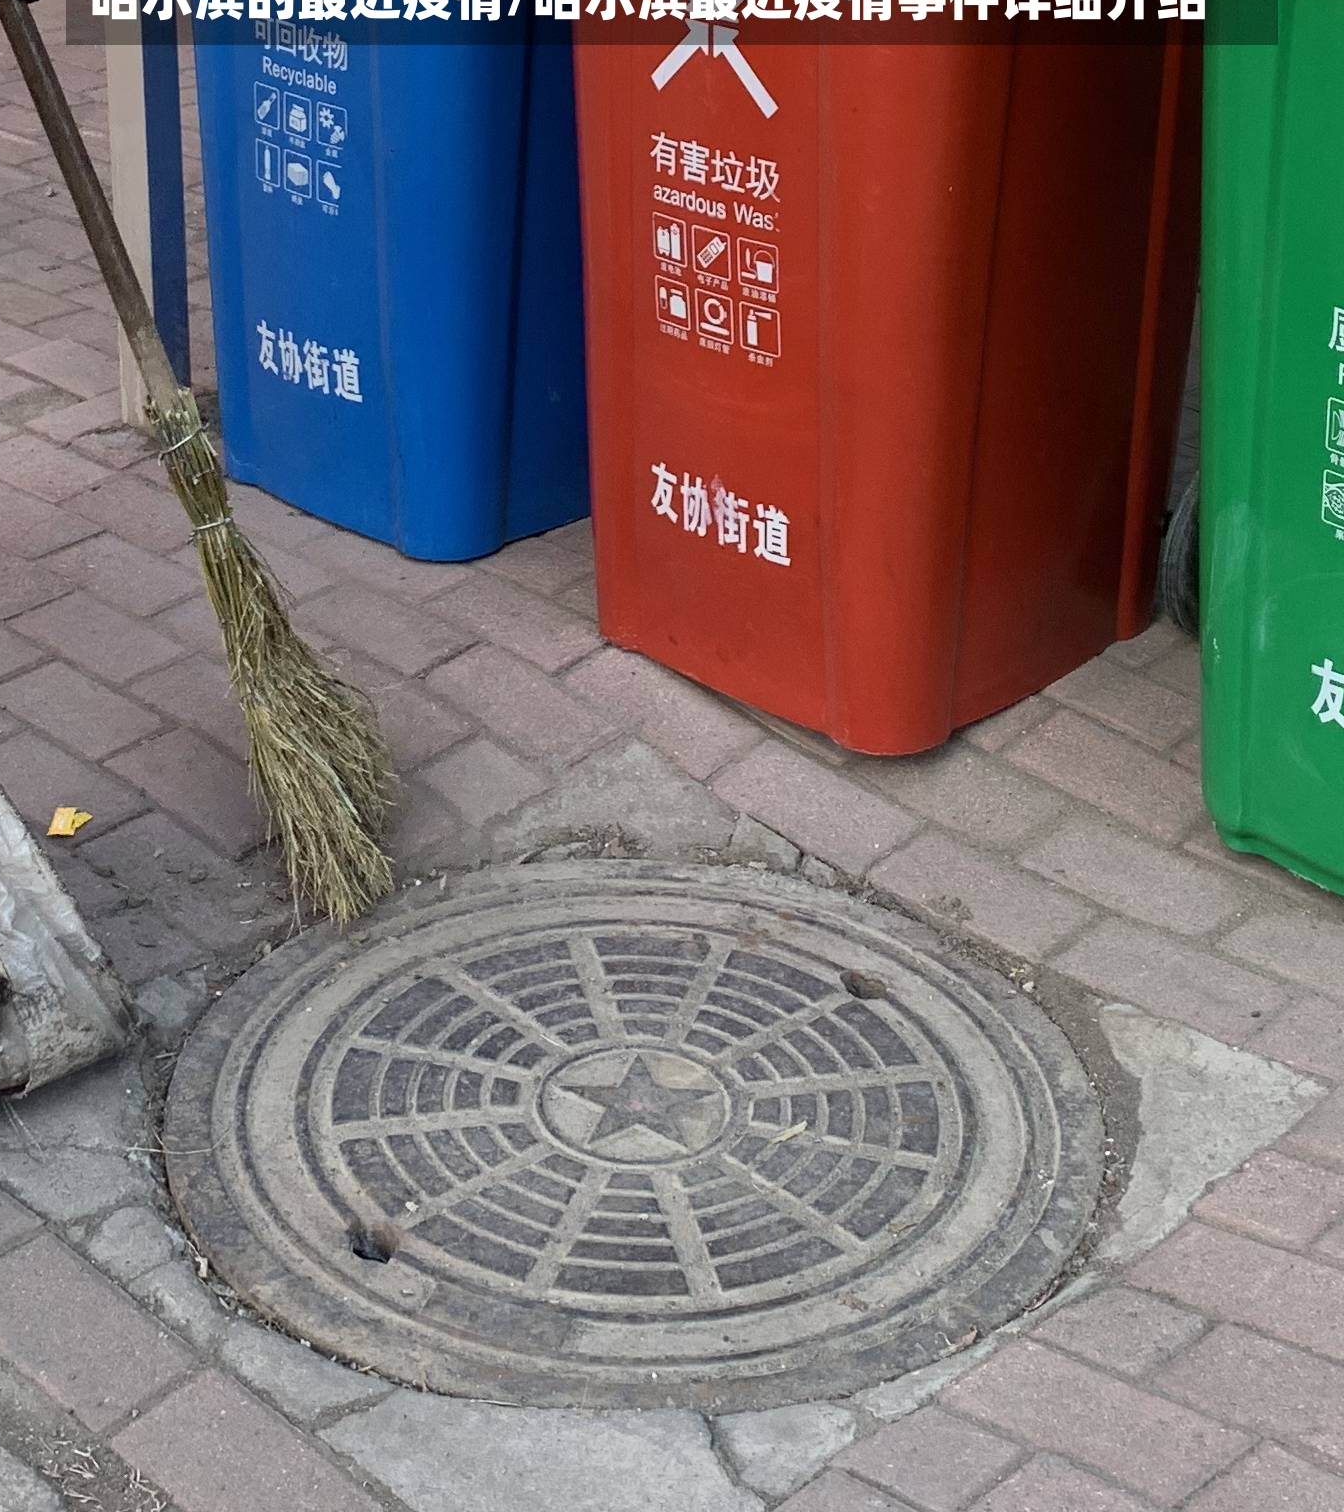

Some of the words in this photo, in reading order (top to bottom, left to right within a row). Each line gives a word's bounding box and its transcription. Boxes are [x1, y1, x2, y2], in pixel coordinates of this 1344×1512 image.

[254, 17, 348, 71] 可回收物
[262, 55, 337, 95] Recyclable
[650, 132, 781, 203] 有害垃圾
[653, 184, 727, 220] azardous
[733, 201, 780, 232] Was
[257, 319, 363, 403] 友协街道
[651, 462, 792, 567] 友协街道
